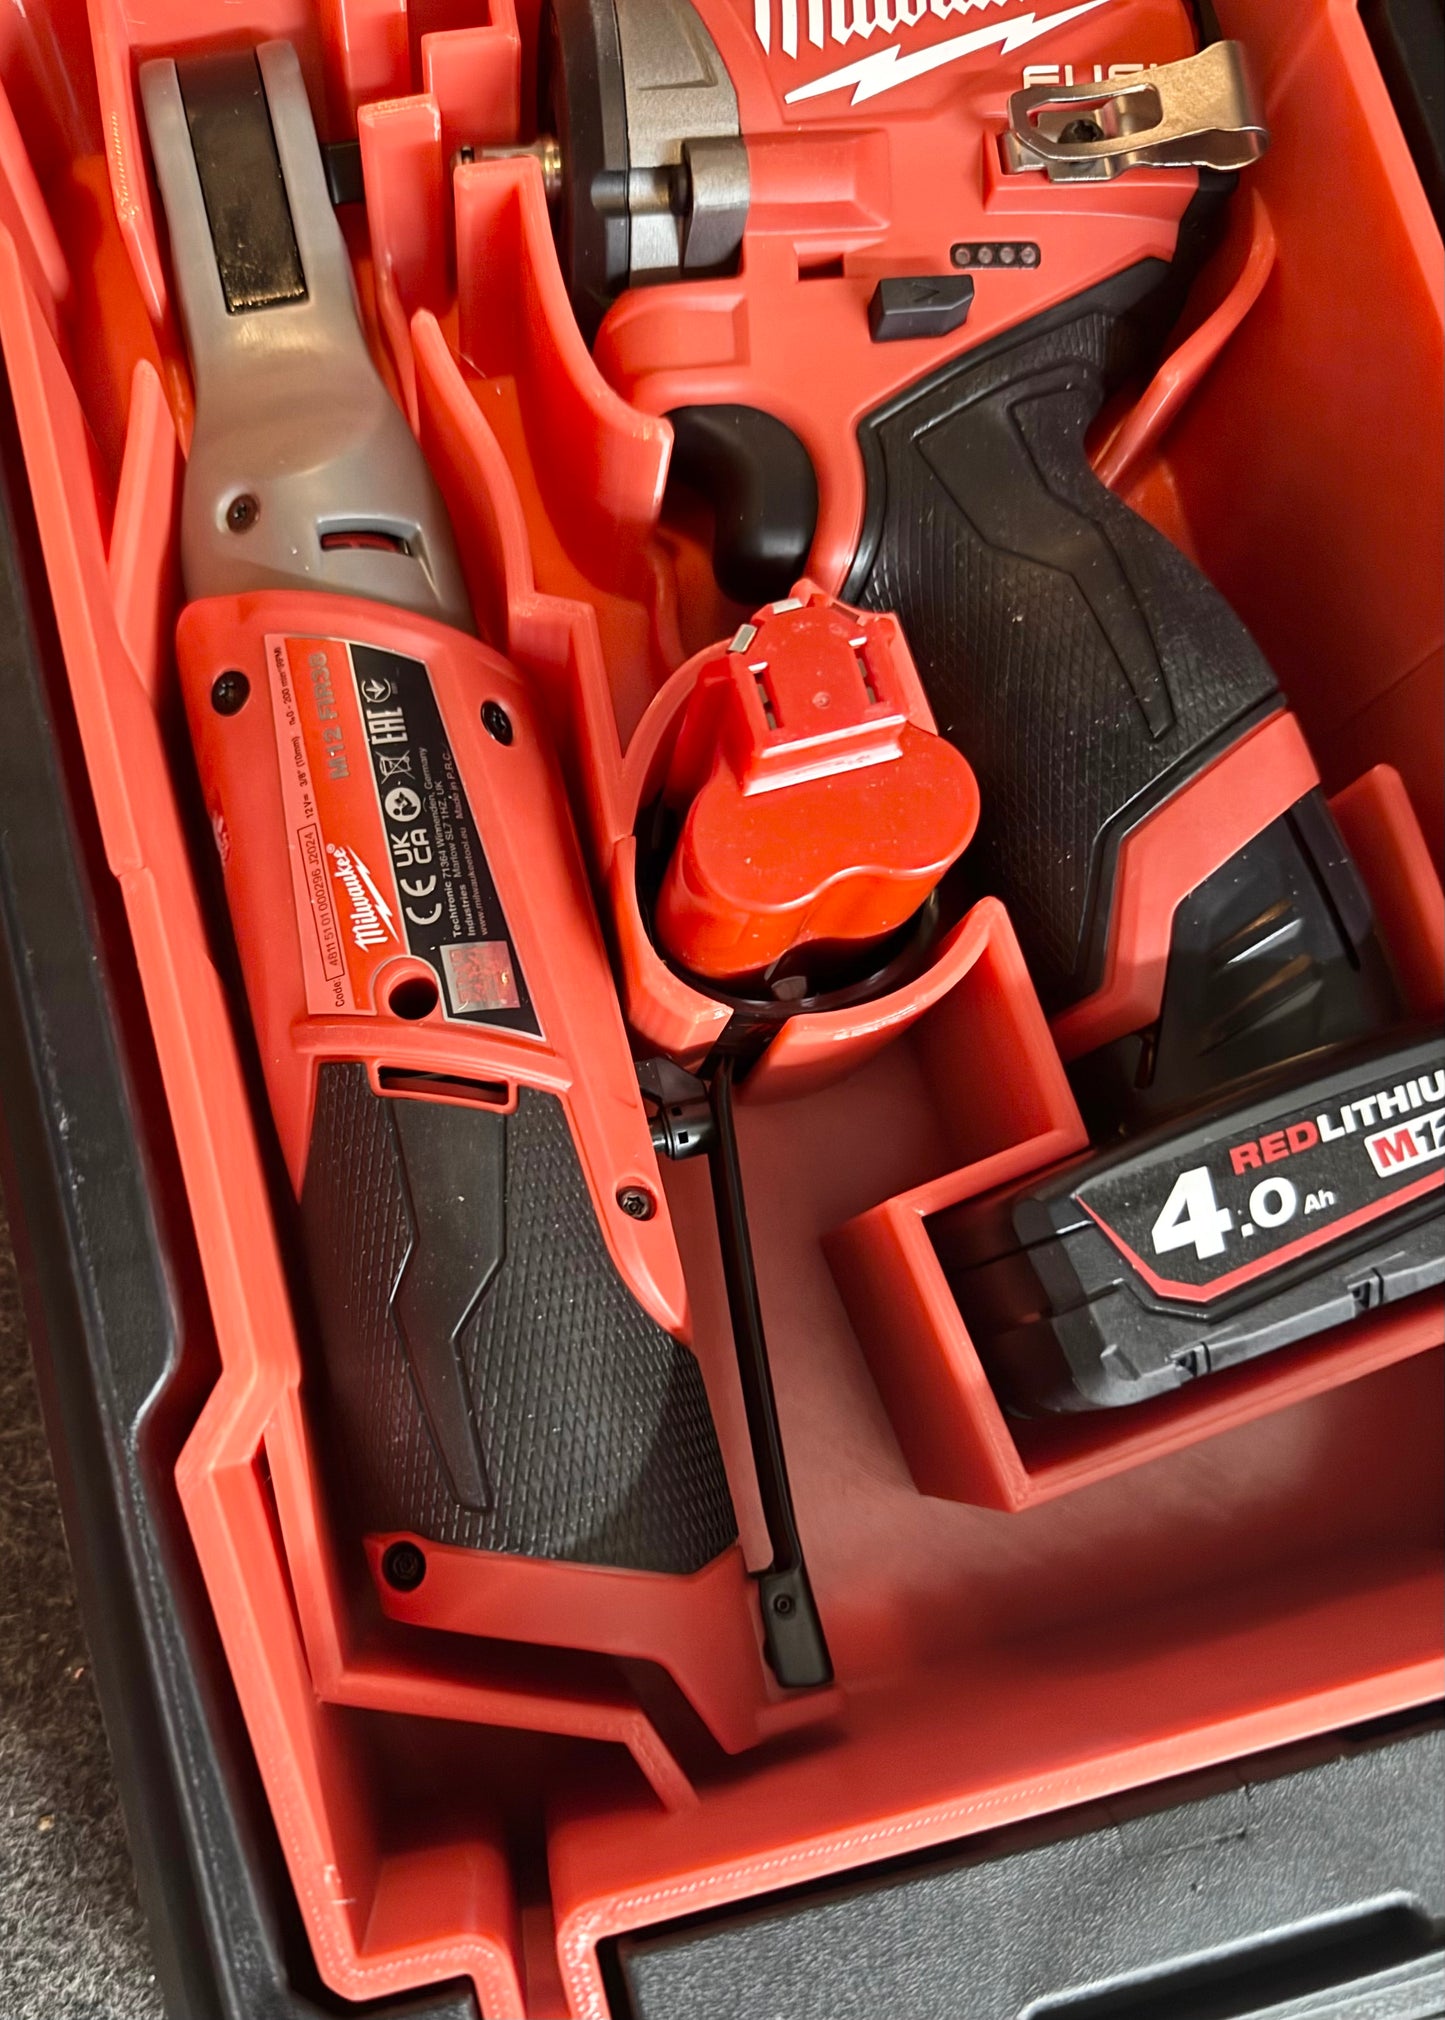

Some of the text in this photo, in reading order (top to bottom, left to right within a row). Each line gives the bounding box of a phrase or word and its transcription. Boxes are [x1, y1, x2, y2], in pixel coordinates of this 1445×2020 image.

[308, 652, 349, 779] M12 FIR38
[419, 746, 434, 790] Germany
[435, 780, 444, 795] UK
[449, 781, 457, 790] in
[453, 793, 463, 819] Made
[443, 822, 454, 841] SL7
[305, 833, 319, 865] J2024
[448, 842, 462, 877] Marlow
[439, 850, 451, 878] 71364
[460, 827, 488, 935] www.milwaukeetool.eu
[444, 881, 462, 937] Techtronic
[459, 884, 476, 936] Industries
[322, 928, 334, 940] 51
[326, 942, 338, 966] 4811
[332, 979, 344, 1006] Code:
[1304, 1189, 1335, 1214] Ah
